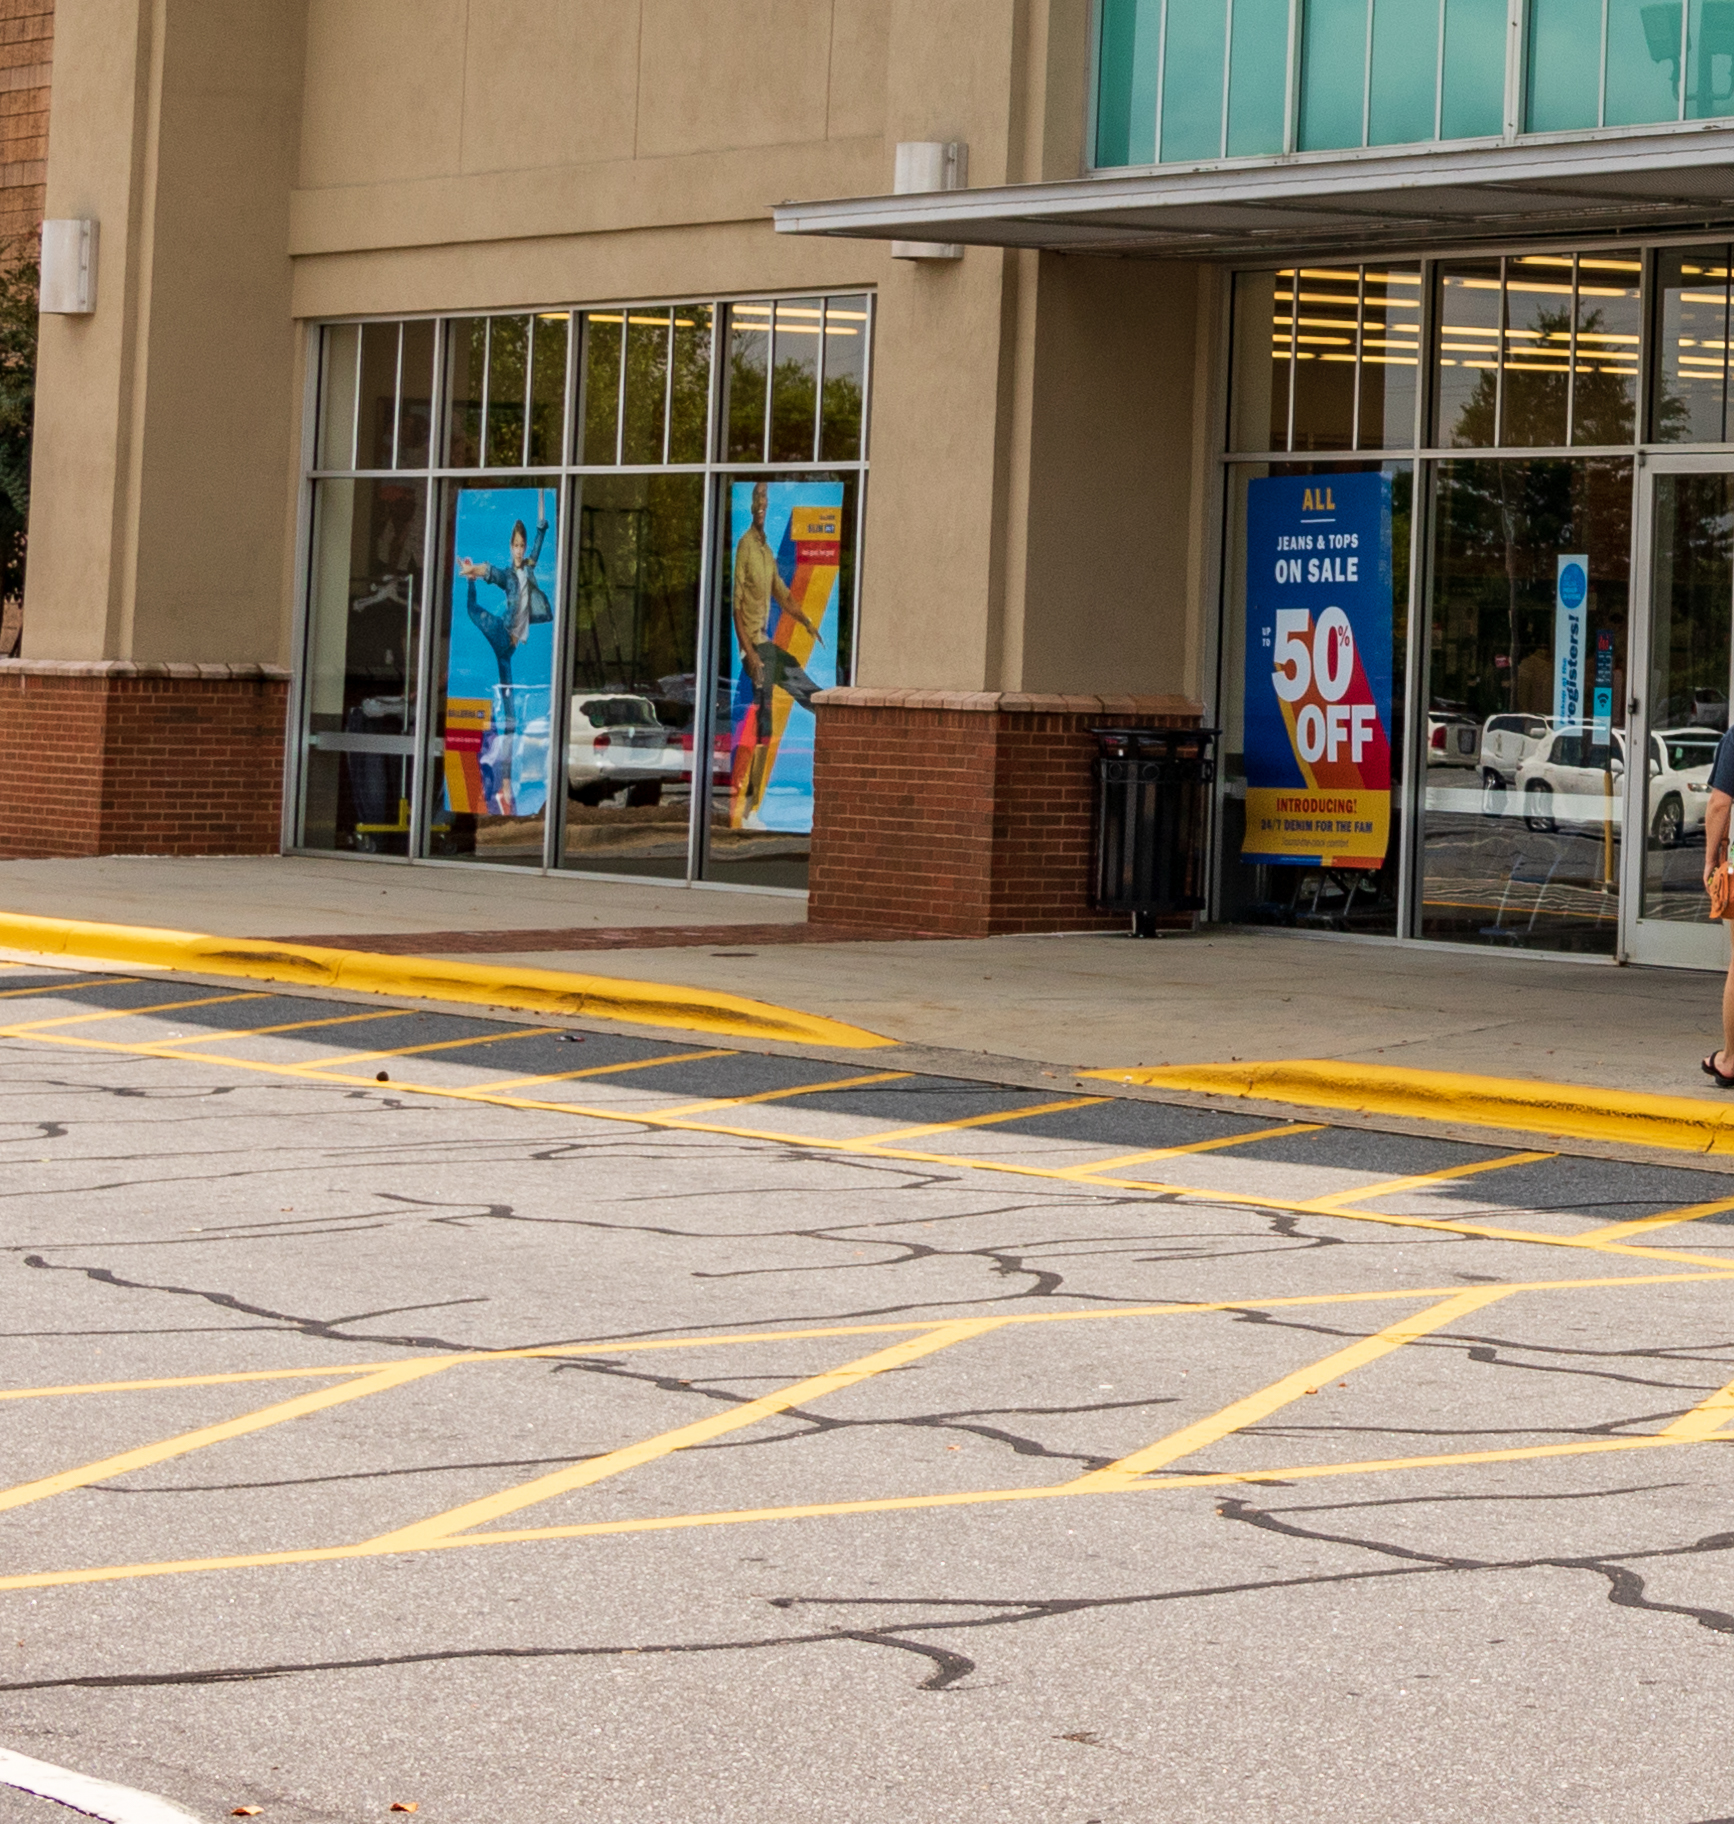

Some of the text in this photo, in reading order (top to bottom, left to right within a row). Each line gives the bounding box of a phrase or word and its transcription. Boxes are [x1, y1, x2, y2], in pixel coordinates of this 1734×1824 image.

[1302, 487, 1336, 511] ALL
[1277, 533, 1359, 551] JEANS & TOPS
[1275, 557, 1359, 584] ON SALE
[1262, 627, 1271, 636] UP
[1262, 638, 1271, 647] TO
[1568, 614, 1580, 725] registers!
[1296, 703, 1376, 763] OFF
[1276, 798, 1357, 813] INTRODUCING!
[1284, 820, 1313, 831] DENIM
[1315, 820, 1333, 832] FOR
[1336, 821, 1352, 832] THE
[1354, 822, 1373, 833] FAM
